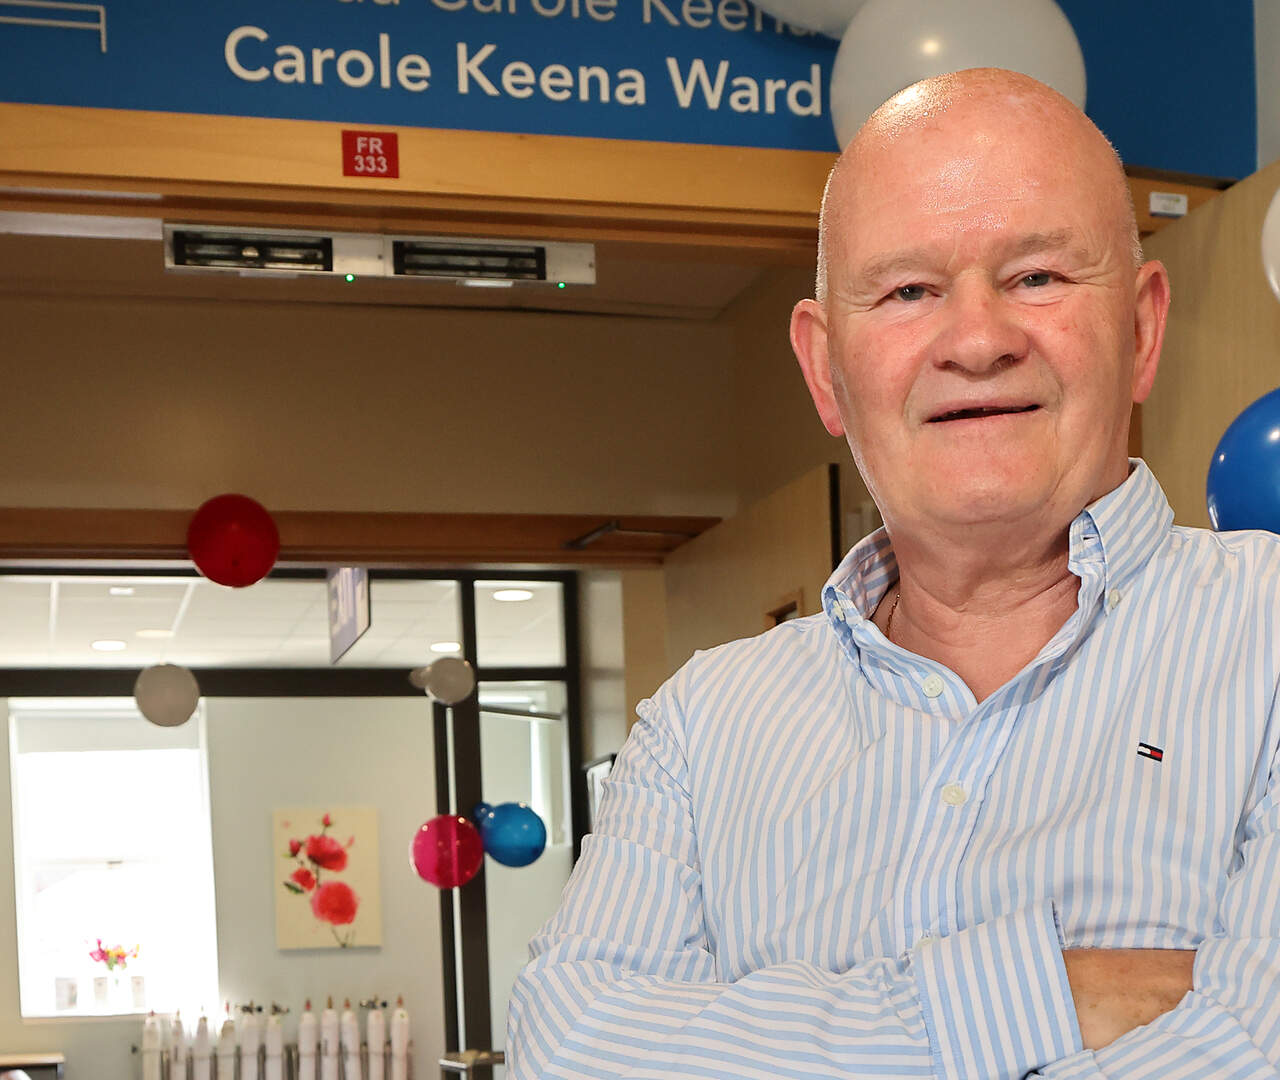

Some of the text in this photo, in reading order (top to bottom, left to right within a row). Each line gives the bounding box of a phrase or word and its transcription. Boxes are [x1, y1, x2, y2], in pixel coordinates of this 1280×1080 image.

[224, 26, 822, 116] Carole Keena Ward
[357, 136, 383, 154] FR
[354, 155, 387, 173] 333
